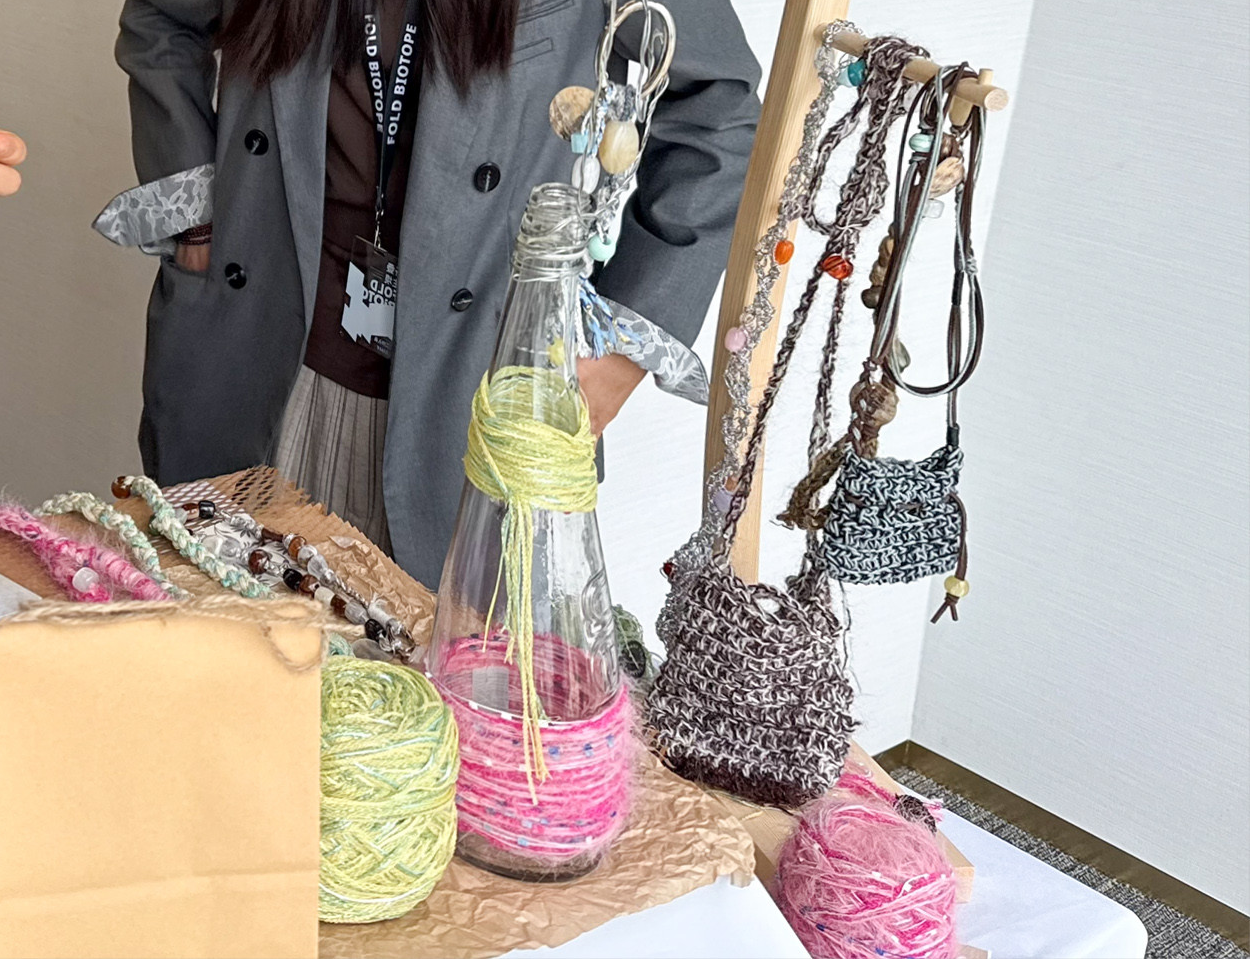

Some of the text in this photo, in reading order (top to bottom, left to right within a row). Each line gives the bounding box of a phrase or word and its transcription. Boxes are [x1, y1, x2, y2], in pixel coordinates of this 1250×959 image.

[364, 13, 384, 134] FOLD BIOTOPE
[387, 22, 417, 146] FOLD BIOTOPE
